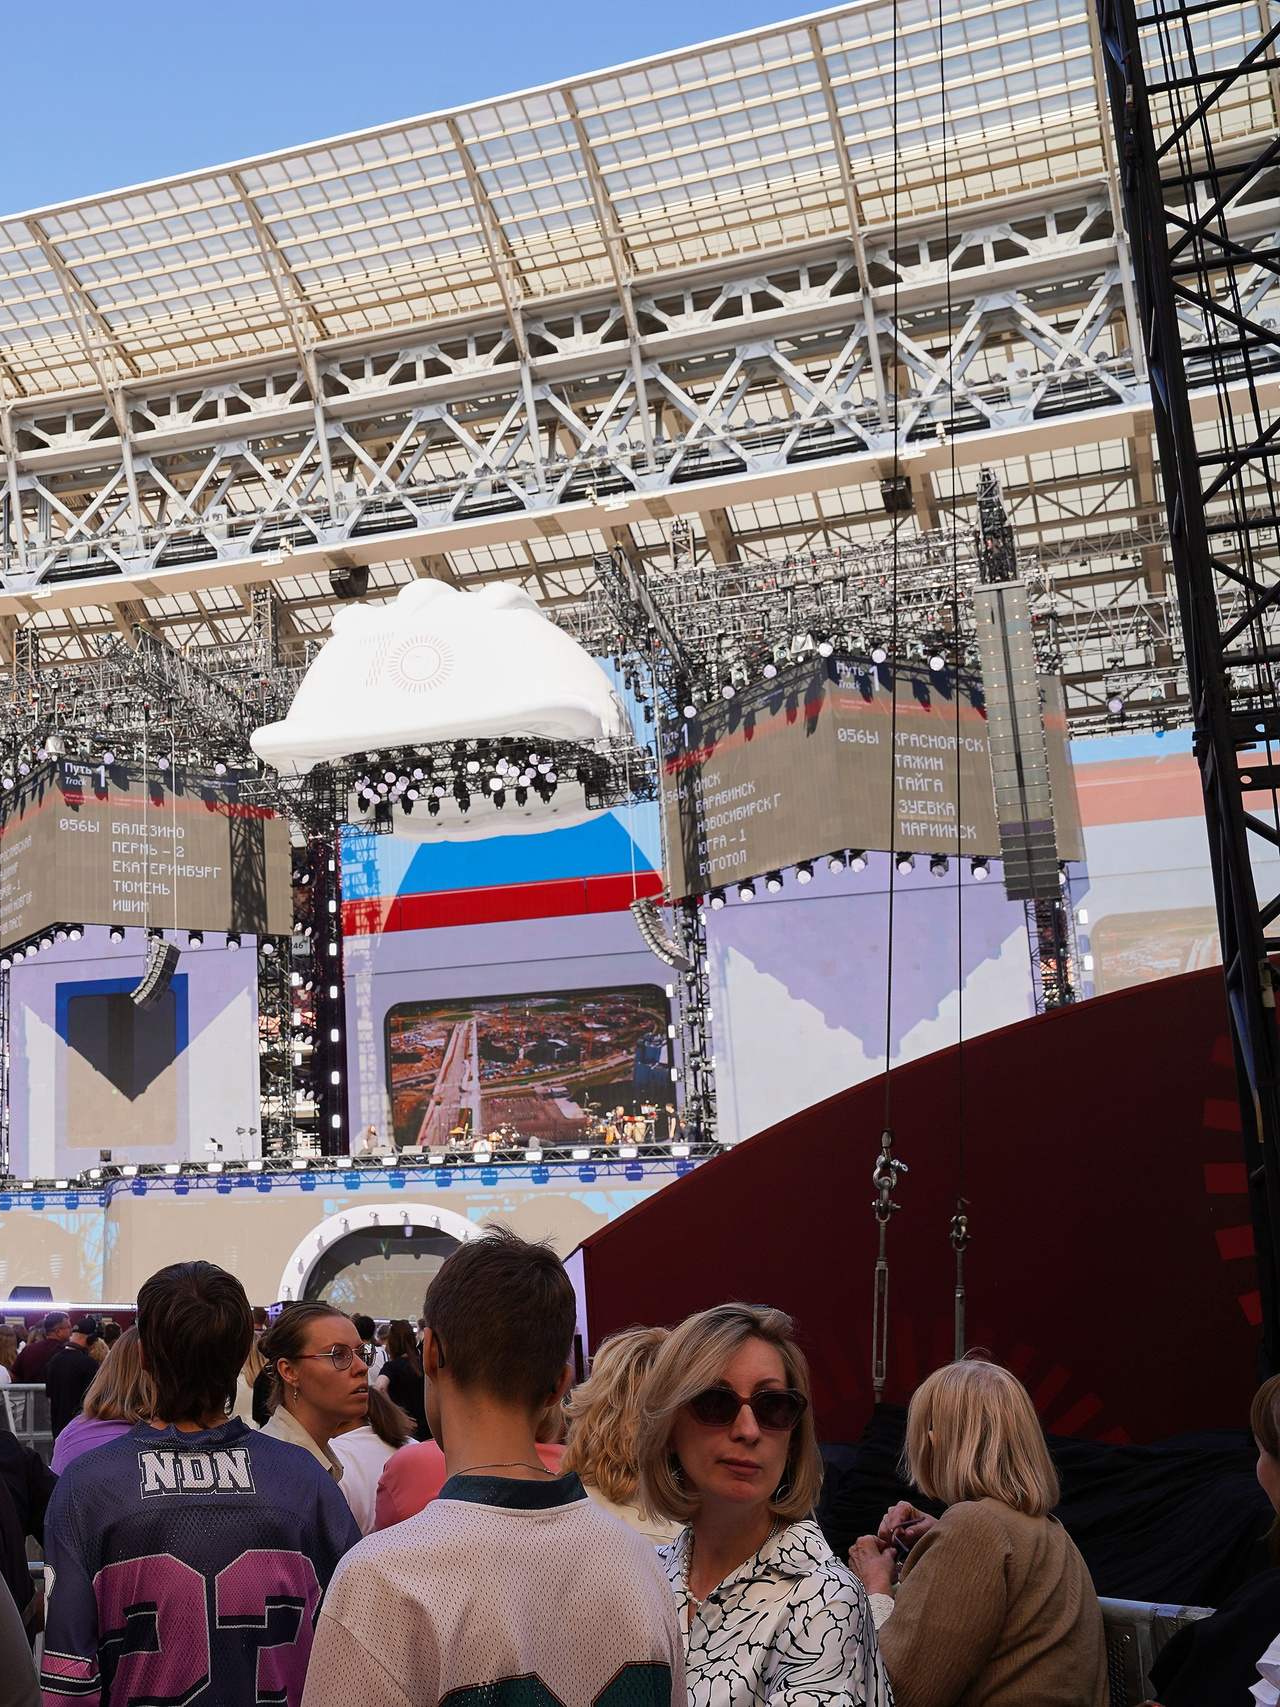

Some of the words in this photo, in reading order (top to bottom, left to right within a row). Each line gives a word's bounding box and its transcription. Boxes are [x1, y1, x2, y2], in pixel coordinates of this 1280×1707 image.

[835, 662, 865, 678] Путь
[868, 665, 880, 692] 1
[681, 723, 688, 747] 1
[894, 754, 944, 771] ТАЖИН
[64, 762, 92, 776] Путь
[96, 765, 106, 788] 1
[65, 777, 87, 787] Track
[694, 772, 721, 792] ОМСК
[895, 772, 944, 792] ТАЙГА
[695, 781, 756, 813] БАРАБИНСК
[697, 797, 772, 834] НОВОСИБИРСК
[898, 799, 956, 816] ЗУЕВКА
[112, 822, 185, 839] БАЛЕЗИНО
[739, 828, 747, 842] 1
[900, 821, 977, 839] МАРИИНСК
[112, 841, 158, 856] ПЕРМЬ
[176, 846, 185, 858] 2
[112, 860, 222, 879] ЕКАТЕРИНБУРГ
[699, 849, 747, 876] БОГОТОЛ
[112, 880, 171, 896] ТЮМЕНЬ
[112, 899, 150, 913] ИШИМ
[291, 942, 304, 950] 46
[138, 1448, 256, 1499] NDN
